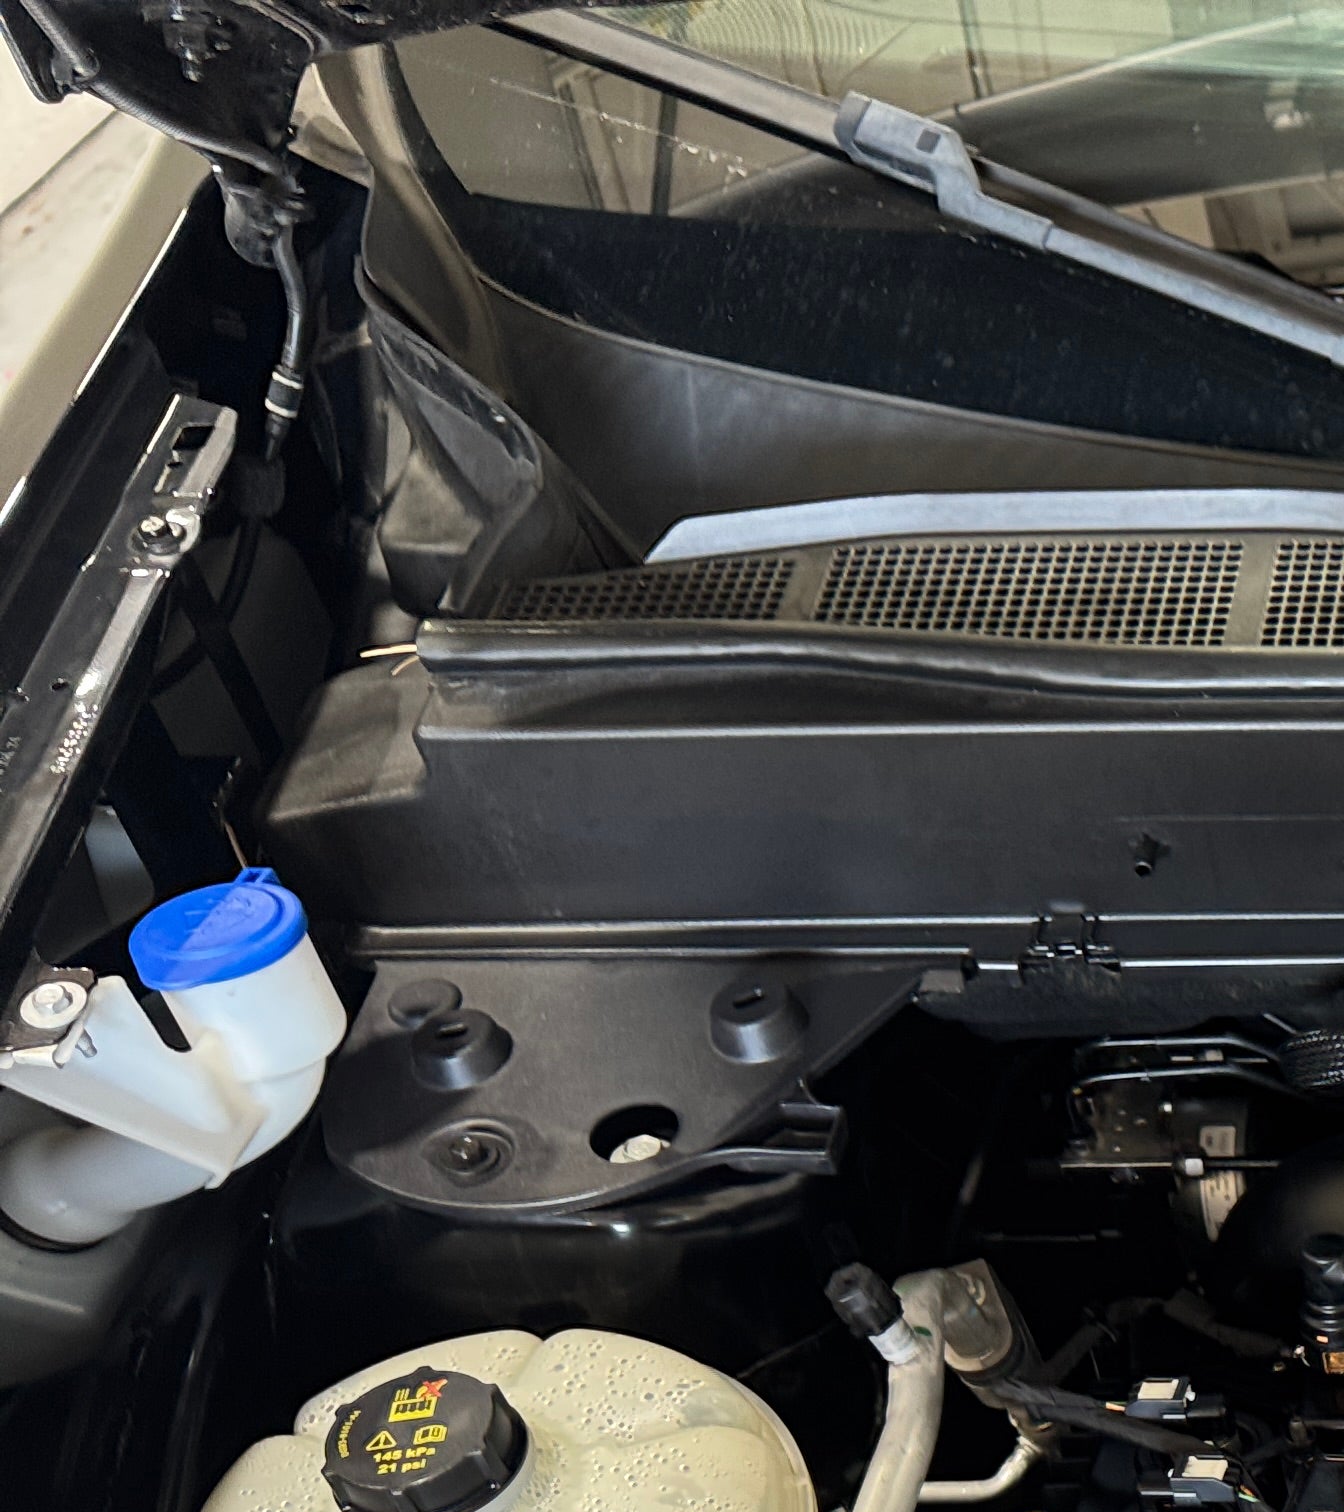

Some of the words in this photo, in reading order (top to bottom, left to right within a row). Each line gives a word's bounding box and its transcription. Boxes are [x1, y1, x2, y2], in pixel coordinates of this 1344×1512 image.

[373, 1449, 402, 1463] 145
[405, 1446, 436, 1458] kPa
[377, 1463, 397, 1475] 21
[401, 1459, 427, 1474] psi
